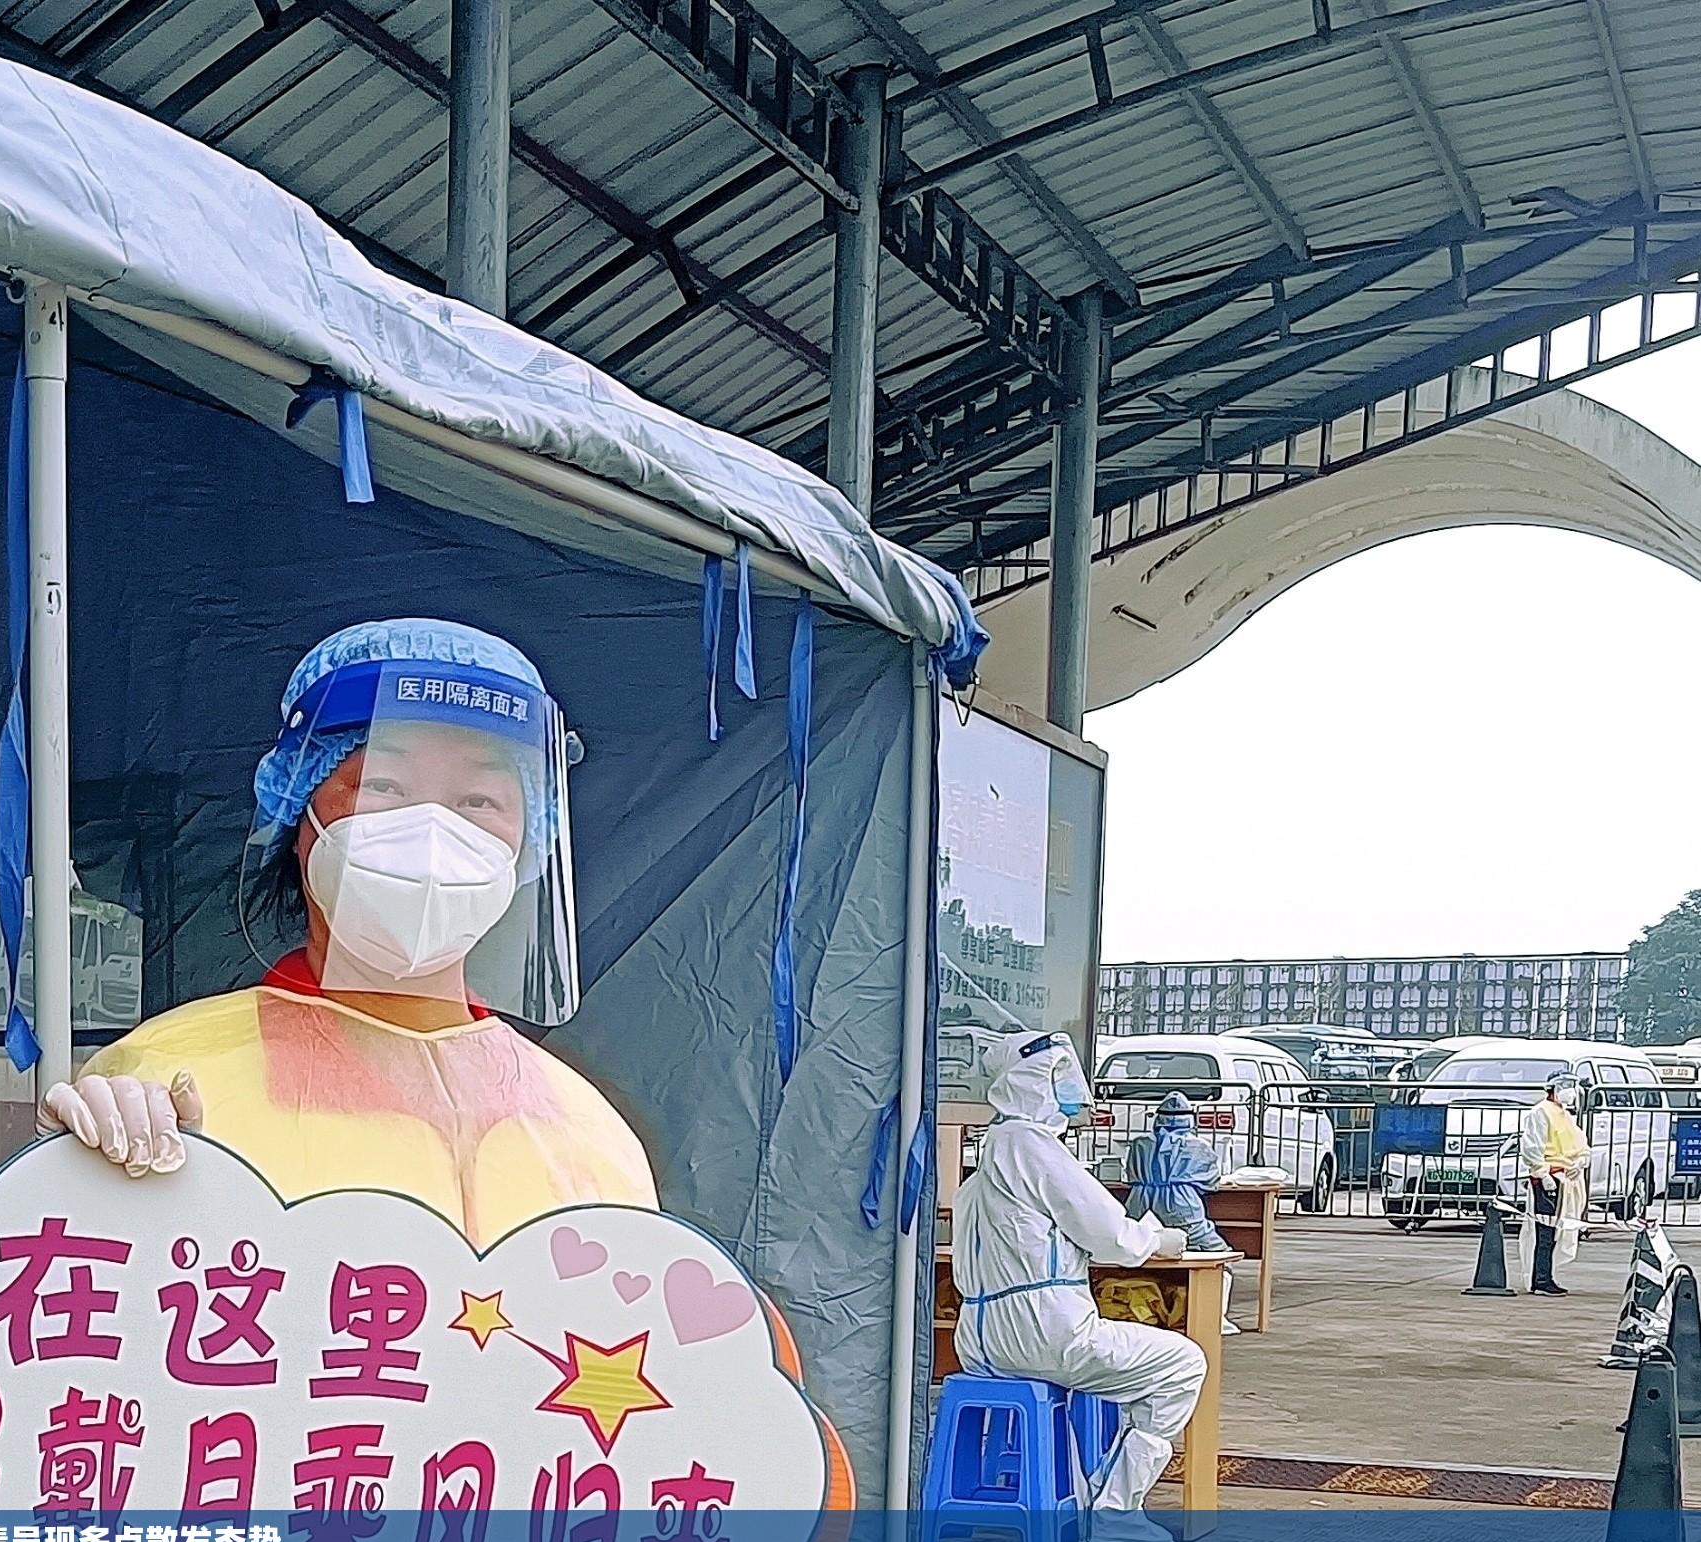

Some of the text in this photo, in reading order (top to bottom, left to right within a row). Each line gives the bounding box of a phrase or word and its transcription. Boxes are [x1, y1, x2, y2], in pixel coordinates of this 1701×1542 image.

[397, 677, 529, 722] 医用隔离面罩
